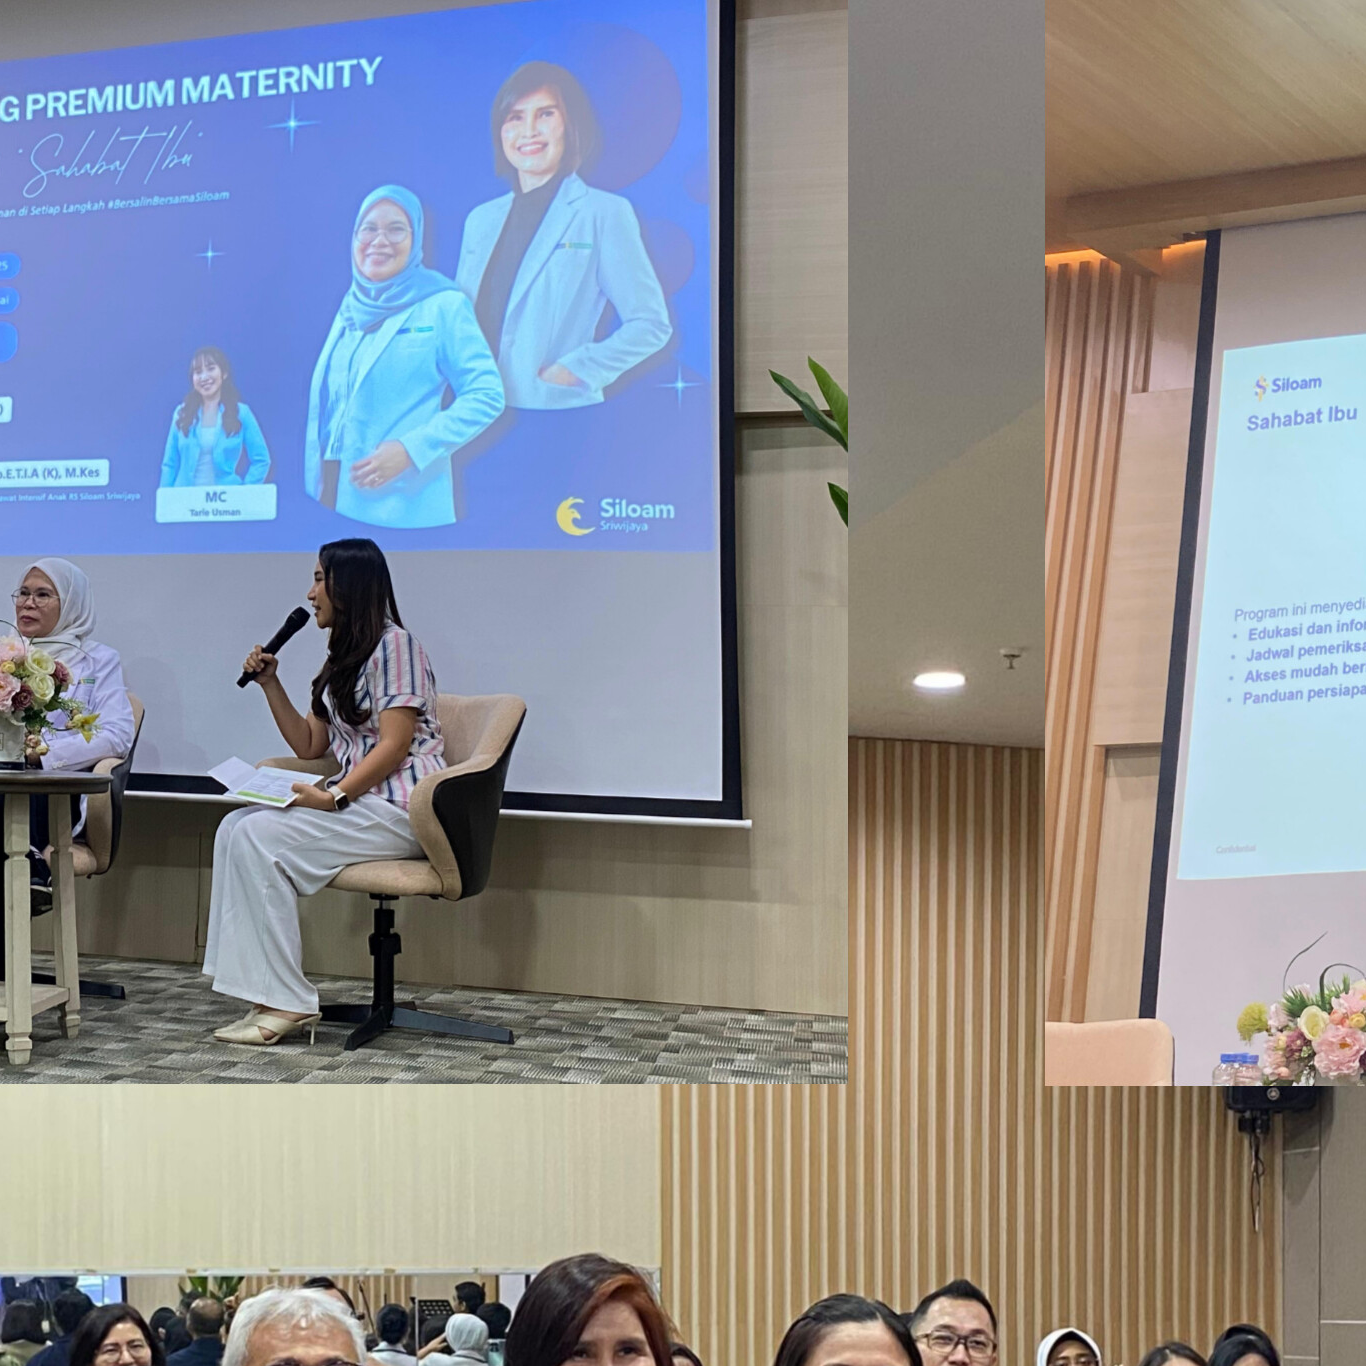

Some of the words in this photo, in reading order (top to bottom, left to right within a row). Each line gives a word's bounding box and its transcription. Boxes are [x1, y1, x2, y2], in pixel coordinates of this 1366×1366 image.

[26, 79, 175, 120] PREMIUM
[181, 56, 383, 105] MATERNITY
[22, 126, 167, 198] Sahabat
[18, 206, 28, 217] di
[30, 203, 60, 216] Setiap
[62, 200, 105, 215] Langkah
[108, 191, 230, 209] #BersalinBersamaSiloam
[1271, 377, 1323, 393] Siloam
[1247, 407, 1323, 431] Sahabat
[1328, 405, 1358, 423] Ibu
[42, 467, 62, 480] (K),
[65, 467, 100, 478] M.Kes
[205, 491, 227, 503] MC
[189, 508, 210, 517] Tarie
[211, 508, 241, 517] Usman
[600, 498, 675, 519] Siloam
[600, 520, 648, 533] Sriwijaya
[1235, 606, 1288, 622] Program
[1292, 602, 1307, 616] ini
[1248, 625, 1303, 641] Edukasi
[1306, 621, 1332, 635] dan
[1246, 645, 1294, 662] Jadwal
[1244, 668, 1286, 683] Akses
[1290, 663, 1338, 679] mudah
[1243, 689, 1303, 705] Panduan
